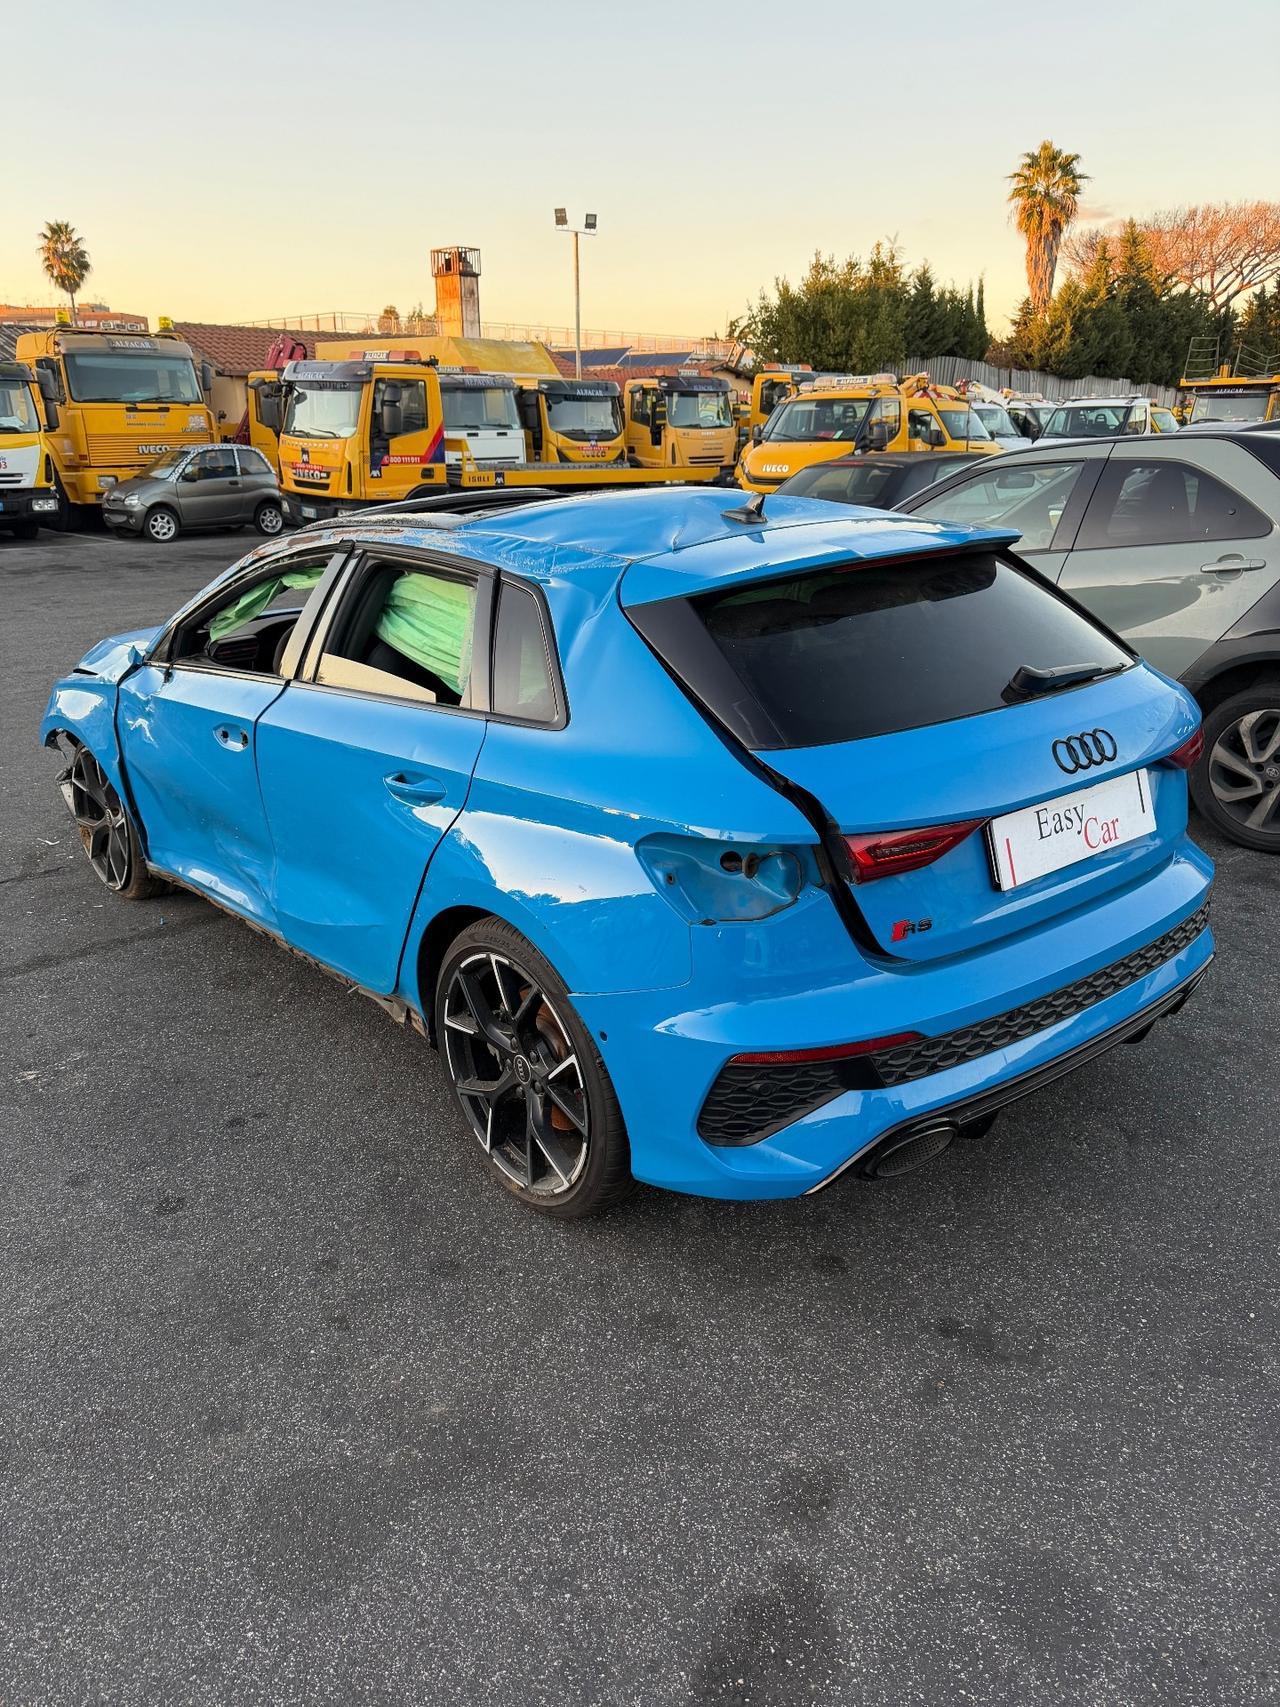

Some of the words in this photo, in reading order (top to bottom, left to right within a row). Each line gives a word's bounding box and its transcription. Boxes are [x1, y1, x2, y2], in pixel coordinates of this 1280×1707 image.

[138, 445, 170, 454] IVECO
[296, 468, 321, 480] IVECO
[762, 464, 789, 473] IVECO
[1034, 804, 1085, 841] Easy
[1083, 815, 1120, 849] Car
